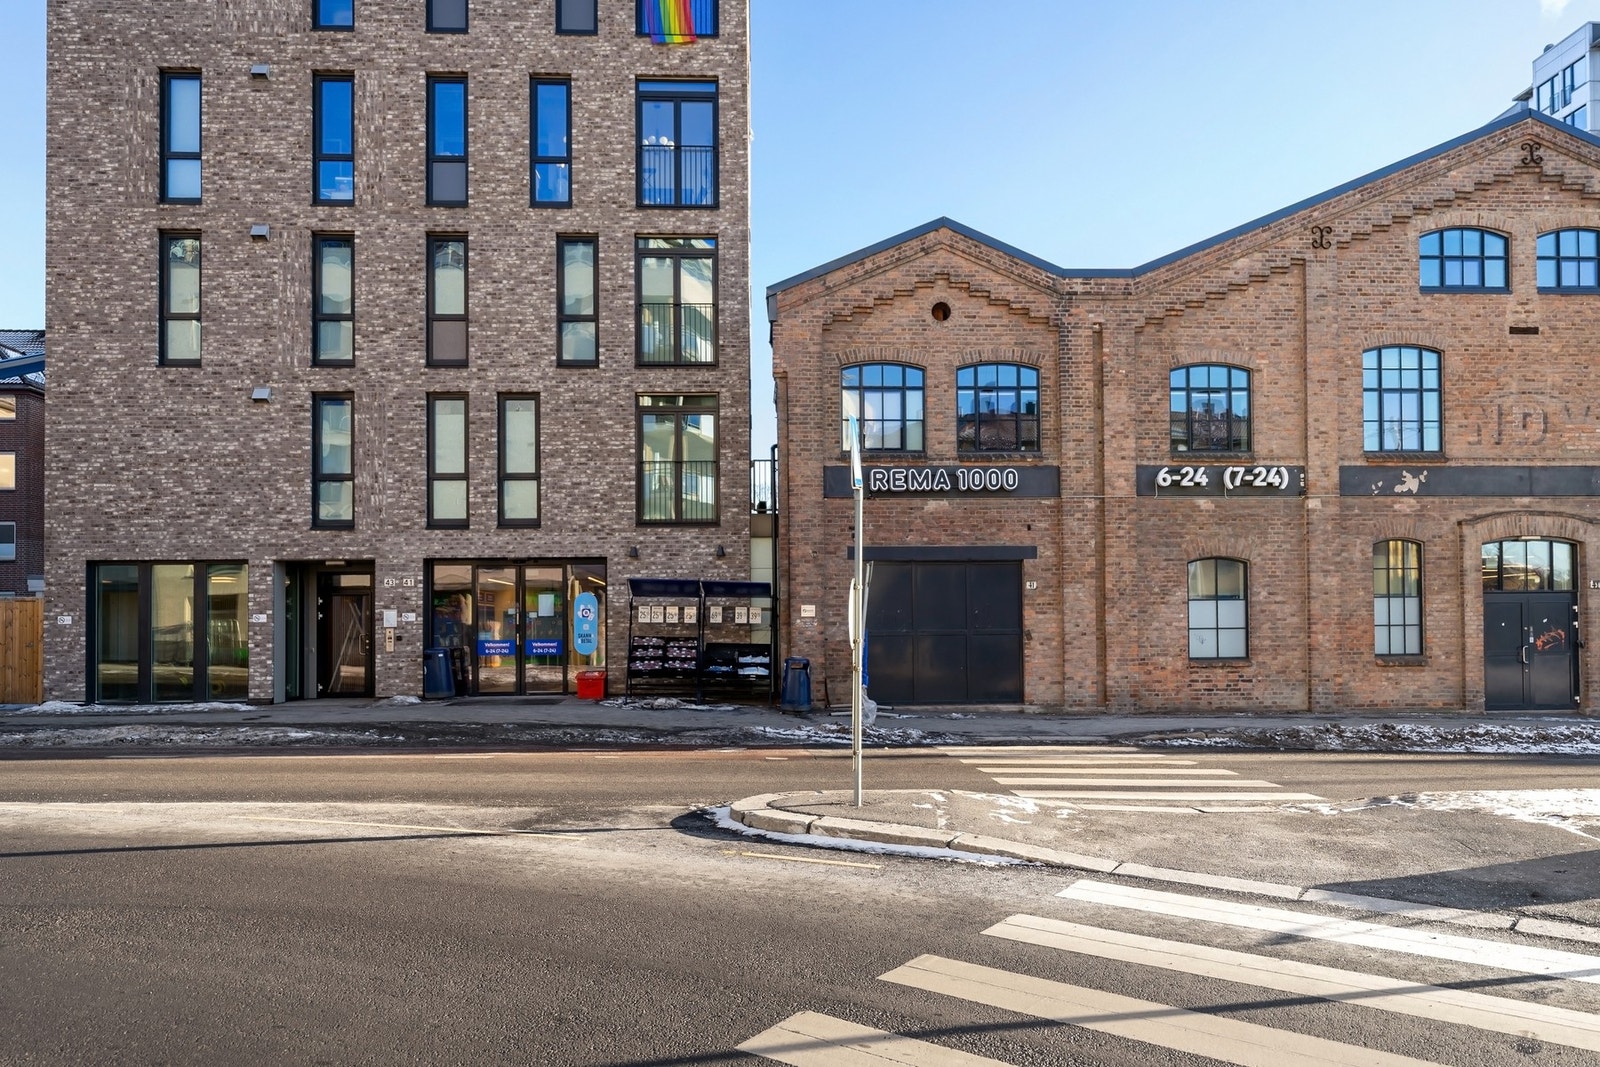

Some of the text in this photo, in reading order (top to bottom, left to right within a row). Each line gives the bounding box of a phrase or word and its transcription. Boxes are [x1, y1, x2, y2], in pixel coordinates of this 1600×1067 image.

[869, 468, 1019, 491] REMA 1000
[1156, 466, 1290, 490] 6-24 (7-24)
